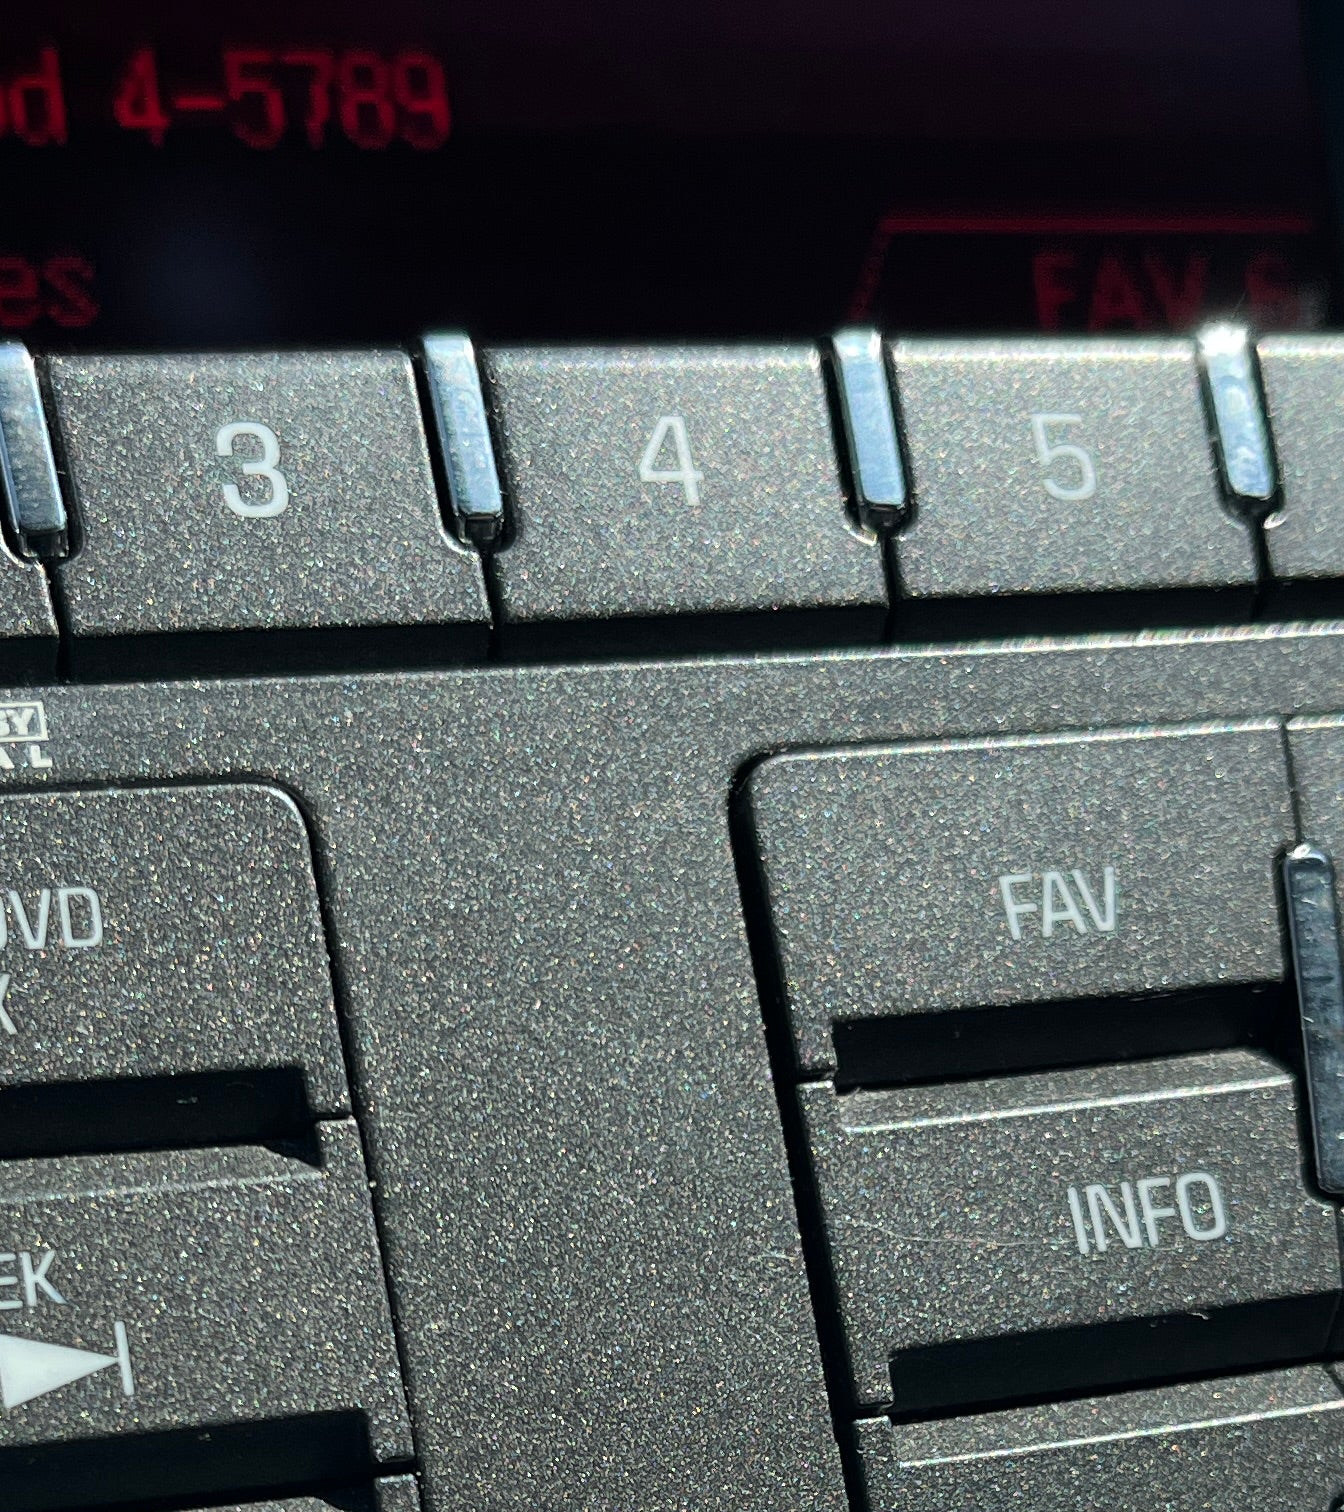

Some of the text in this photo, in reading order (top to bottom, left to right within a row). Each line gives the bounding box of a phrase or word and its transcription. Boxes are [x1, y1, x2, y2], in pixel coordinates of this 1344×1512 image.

[113, 47, 453, 149] 4-5789
[1031, 247, 1210, 331] FAV
[215, 421, 289, 517] 3
[639, 415, 705, 506] 4
[1031, 413, 1097, 499] 5
[998, 865, 1117, 940] FAV
[1067, 1171, 1227, 1255] INFO
